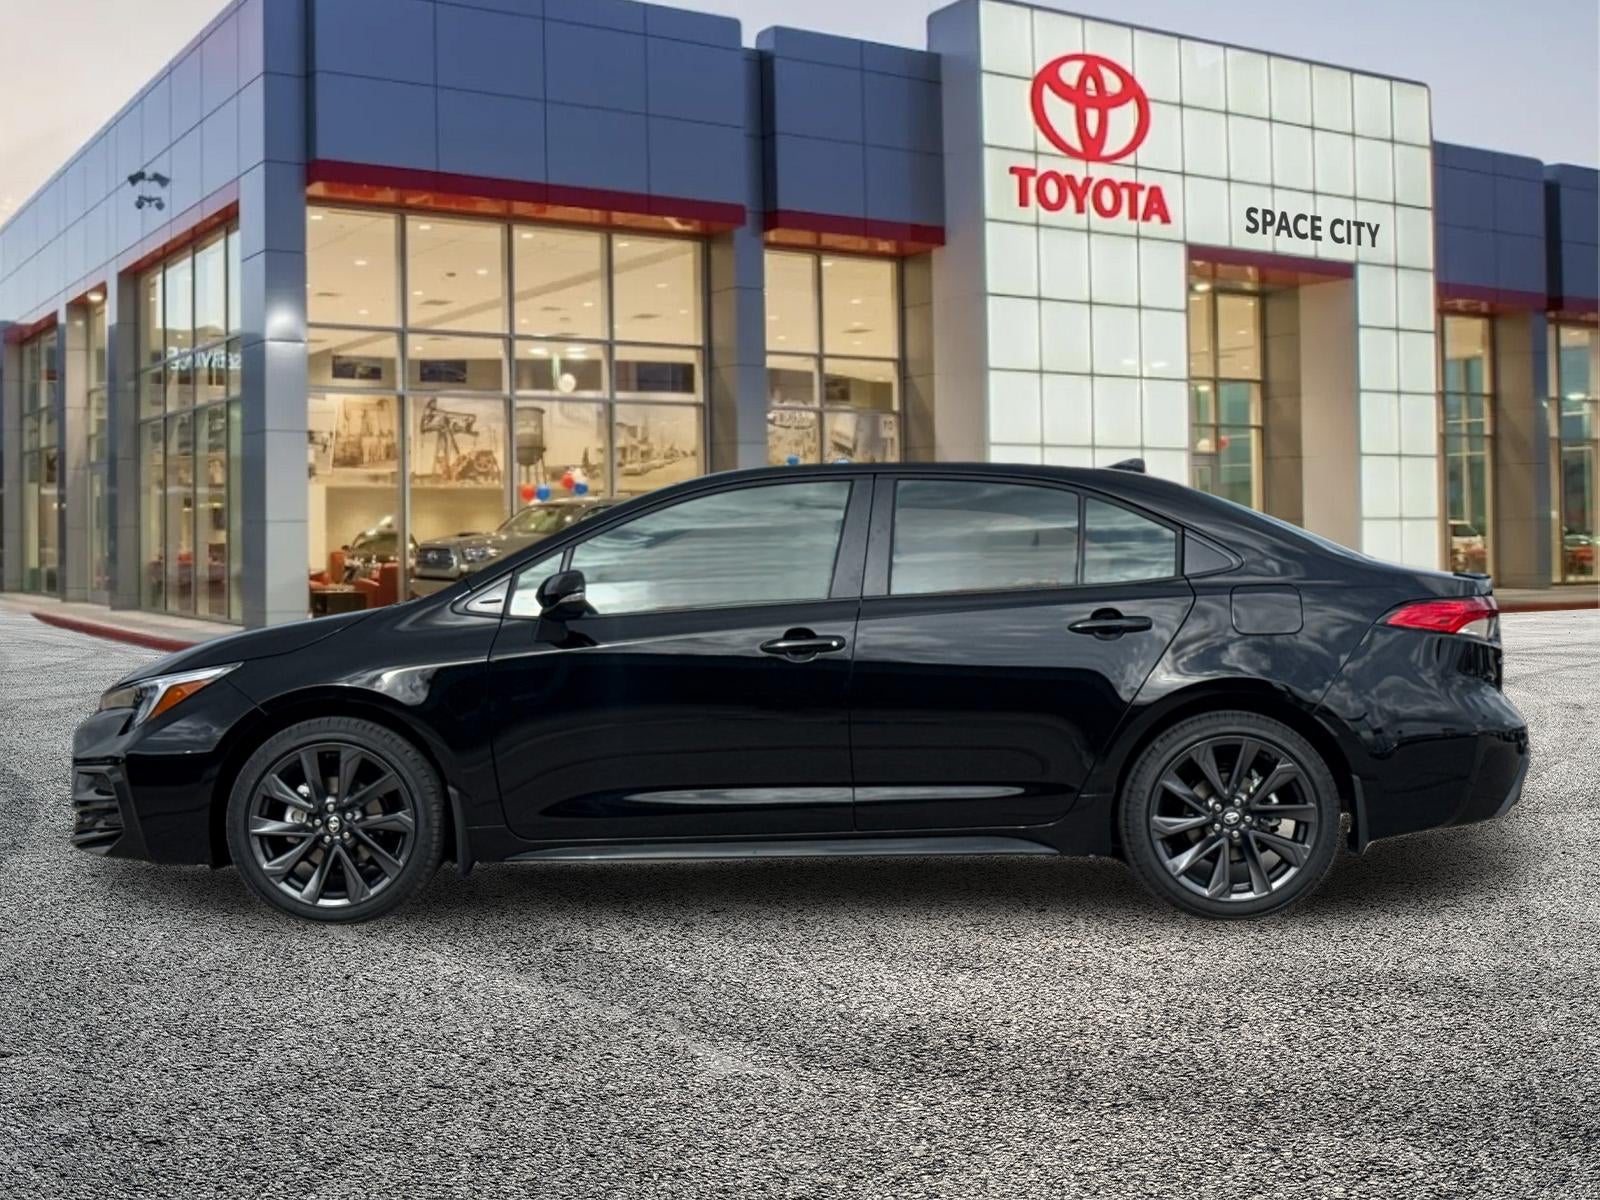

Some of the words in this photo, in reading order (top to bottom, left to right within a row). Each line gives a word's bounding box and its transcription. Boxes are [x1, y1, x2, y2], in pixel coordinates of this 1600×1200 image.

[1010, 166, 1171, 224] TOYOTA
[1245, 207, 1322, 242] SPACE
[1329, 218, 1380, 247] CITY
